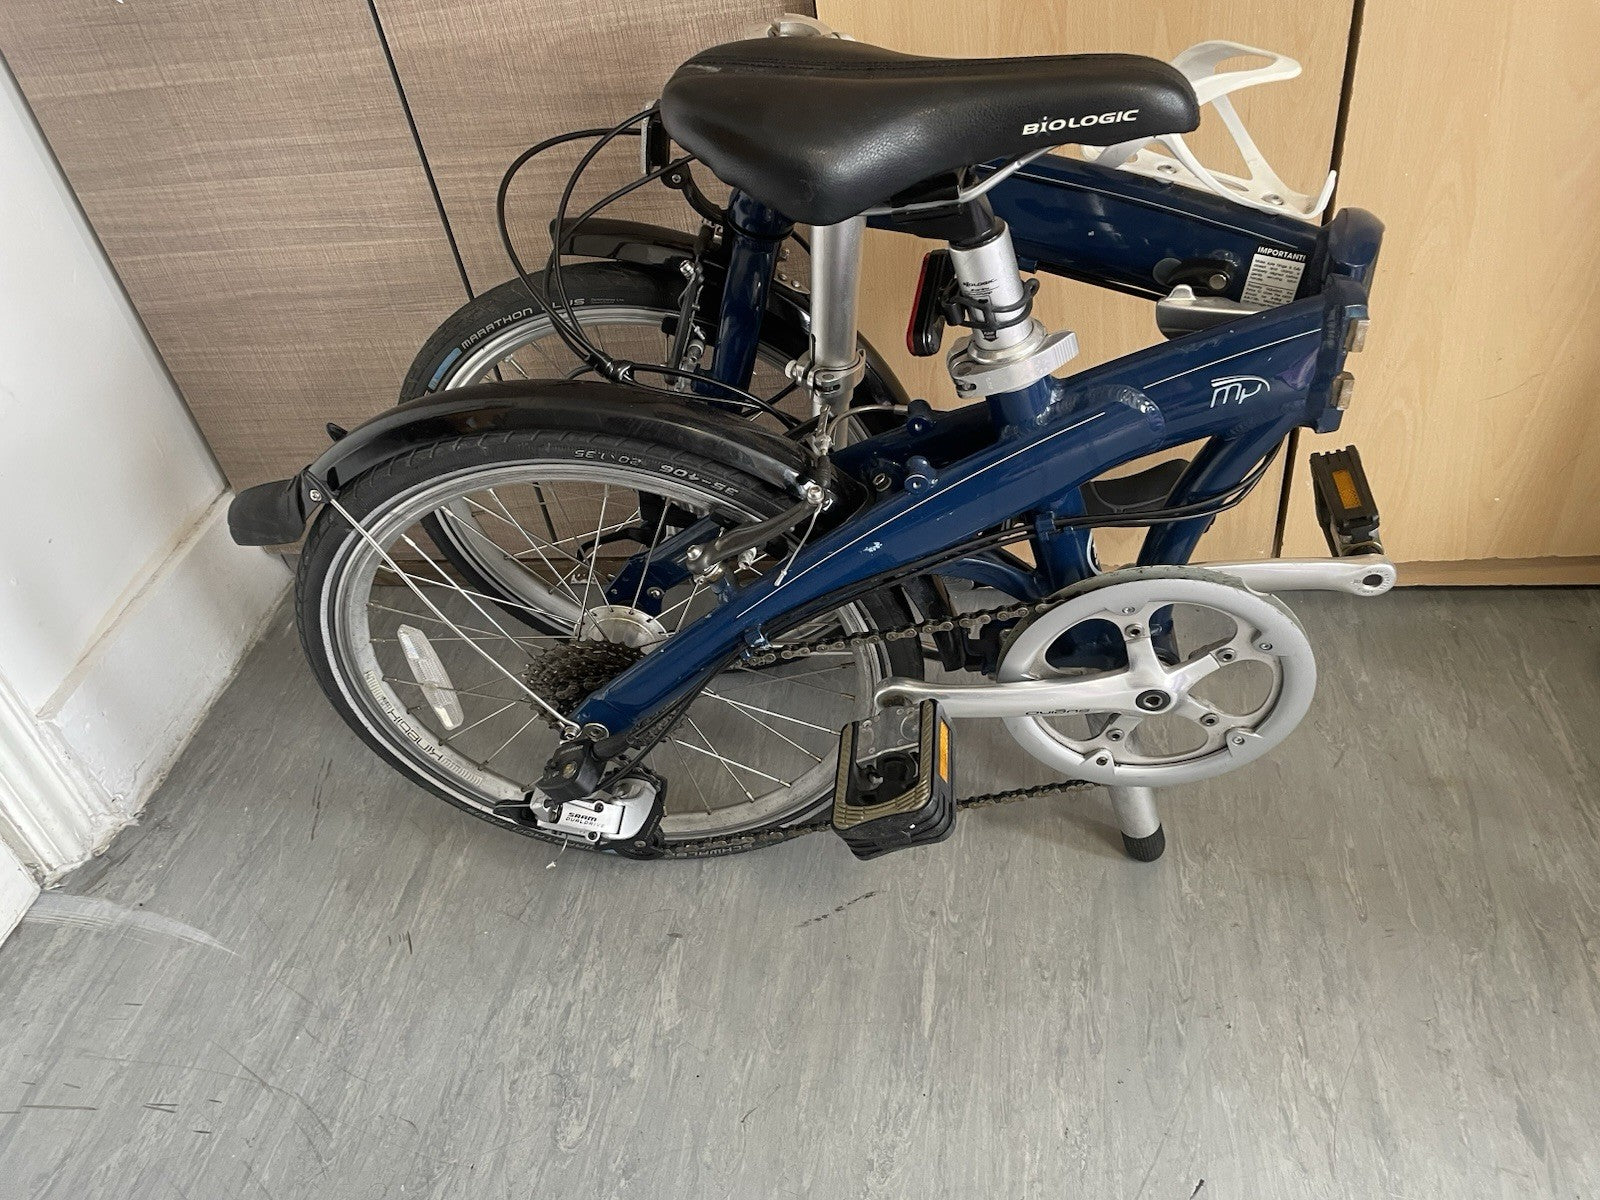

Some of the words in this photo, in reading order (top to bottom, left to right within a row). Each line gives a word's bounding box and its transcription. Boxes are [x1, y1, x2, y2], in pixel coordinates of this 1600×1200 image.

[1257, 246, 1307, 262] IMPORTANT!
[461, 306, 533, 350] MARATHON
[659, 464, 740, 497] 35-406
